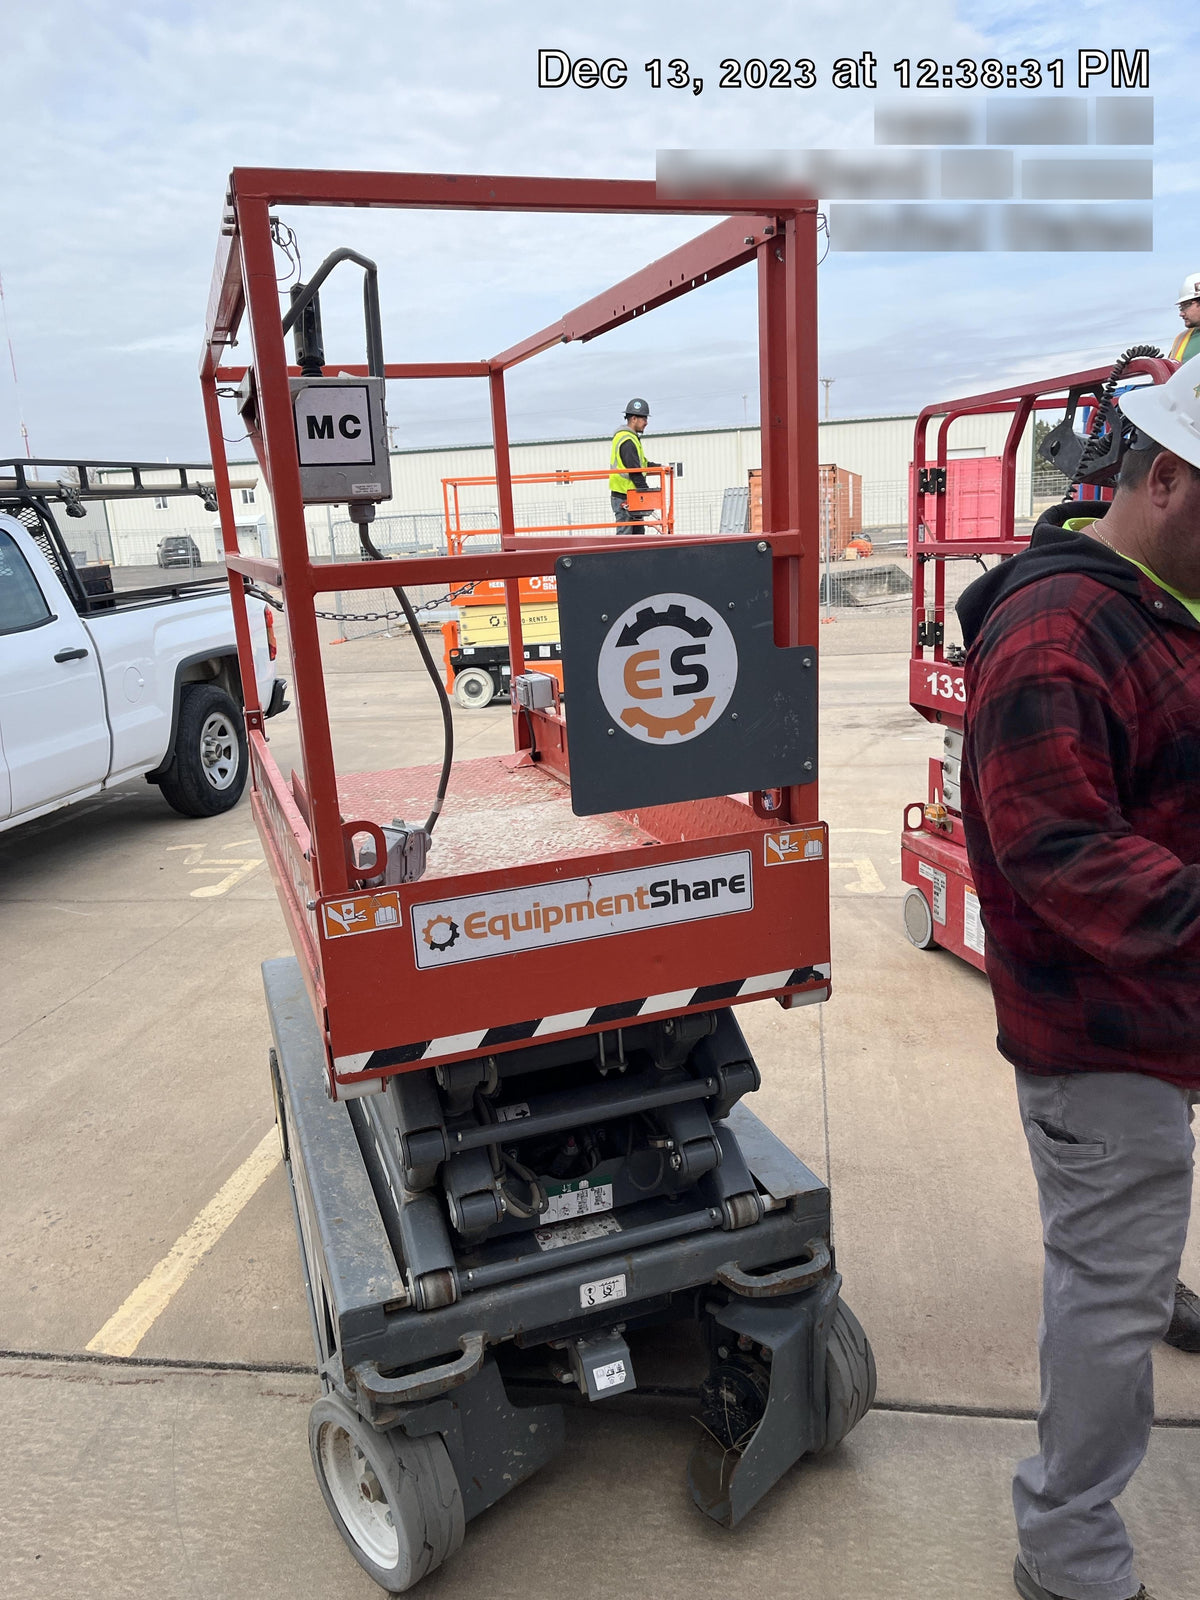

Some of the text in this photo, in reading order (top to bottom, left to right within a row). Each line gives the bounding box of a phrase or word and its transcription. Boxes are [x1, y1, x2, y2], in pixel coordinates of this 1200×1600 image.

[306, 414, 362, 440] MC
[623, 643, 709, 701] ES
[463, 873, 746, 941] EquipmentShare
